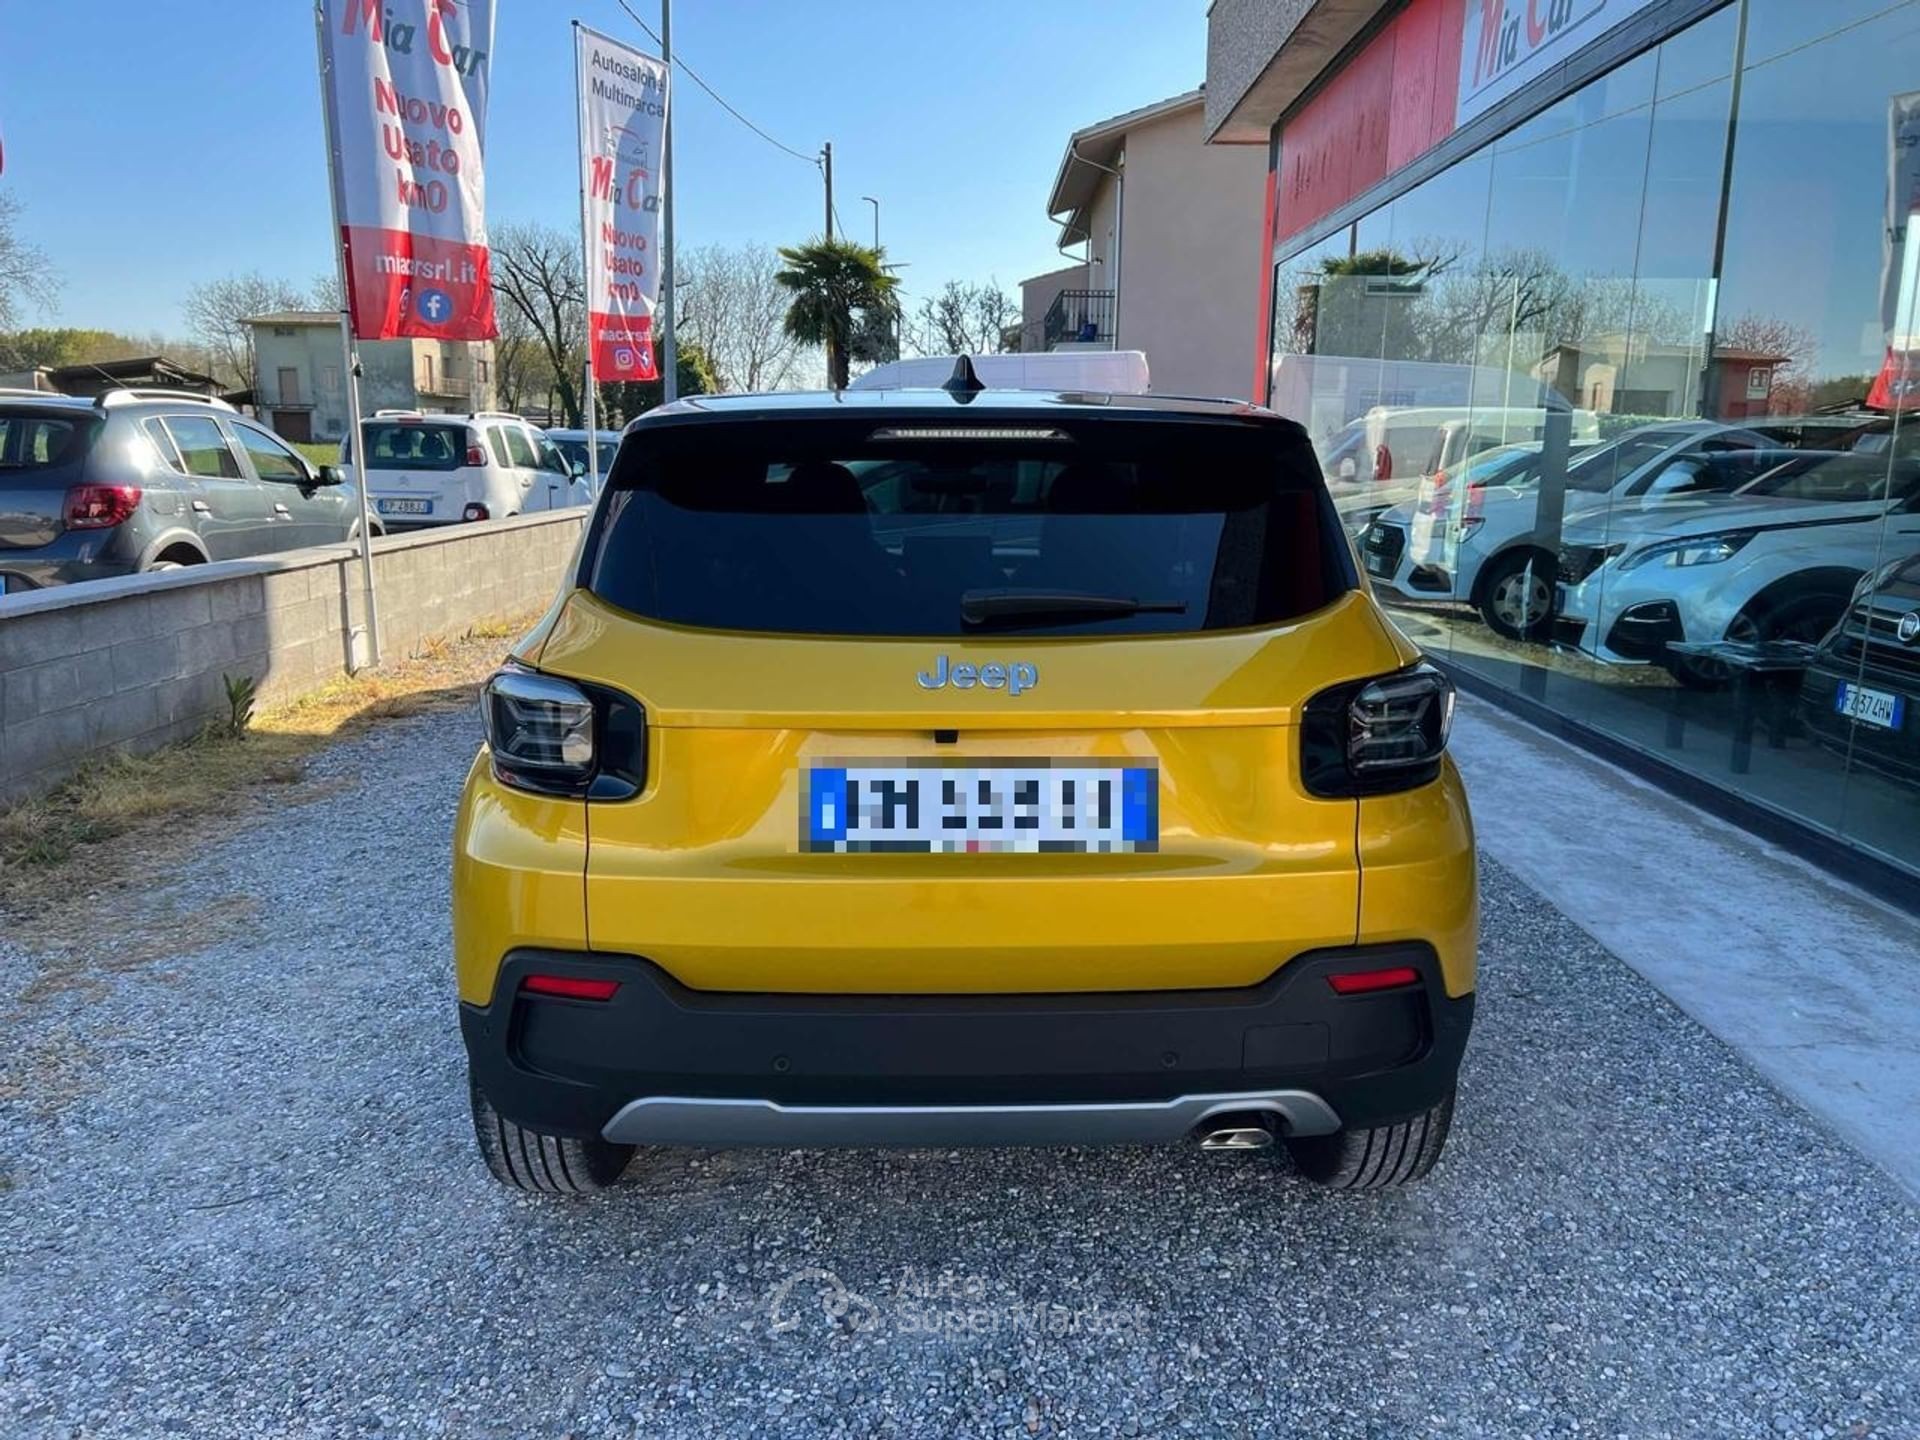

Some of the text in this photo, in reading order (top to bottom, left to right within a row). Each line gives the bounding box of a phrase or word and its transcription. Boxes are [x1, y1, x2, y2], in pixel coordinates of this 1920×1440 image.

[427, 0, 486, 76] Car
[375, 77, 463, 135] Nuovo
[592, 76, 665, 118] Multimarca
[383, 123, 459, 176] Usato
[591, 156, 622, 206] Mia
[916, 655, 1039, 696] Jeep
